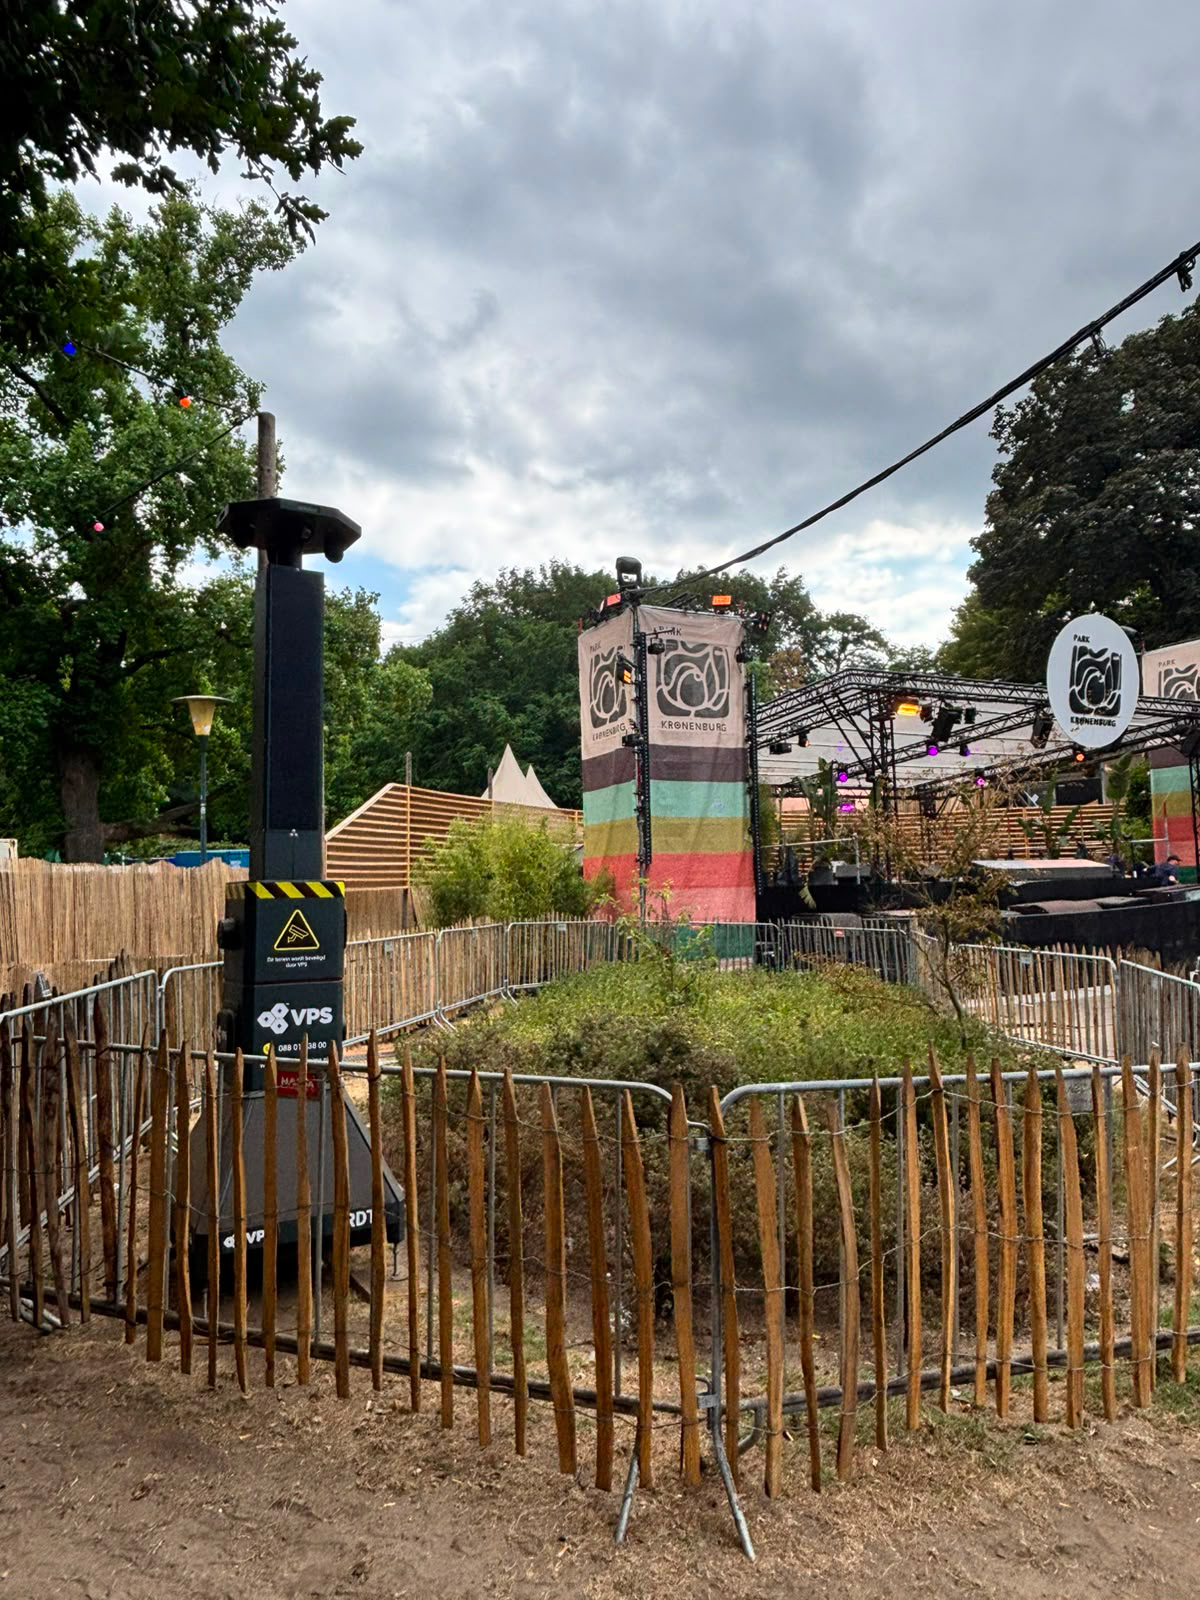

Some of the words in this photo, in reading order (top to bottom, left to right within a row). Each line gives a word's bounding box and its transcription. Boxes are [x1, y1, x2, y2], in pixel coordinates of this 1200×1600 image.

[1073, 634, 1090, 643] PARK
[1158, 659, 1176, 667] PARK
[290, 1007, 333, 1026] VPS
[278, 1044, 292, 1052] 088
[307, 1042, 317, 1050] 38
[246, 1229, 265, 1244] VP
